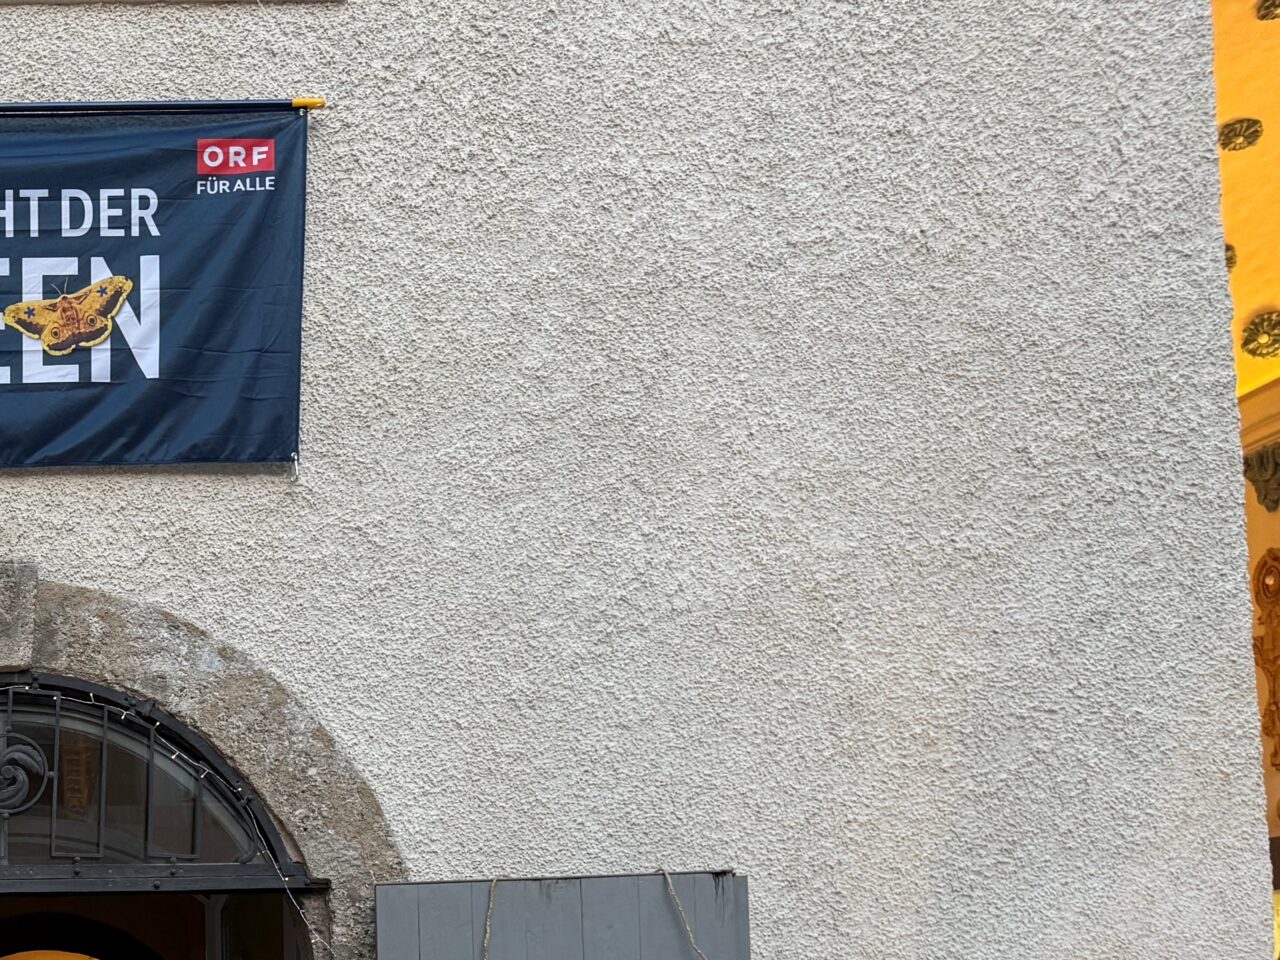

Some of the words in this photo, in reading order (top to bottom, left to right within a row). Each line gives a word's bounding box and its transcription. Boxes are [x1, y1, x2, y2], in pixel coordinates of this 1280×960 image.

[203, 145, 269, 167] ORF
[196, 176, 230, 195] FÜR
[233, 176, 275, 192] ALLE
[61, 187, 161, 238] DER
